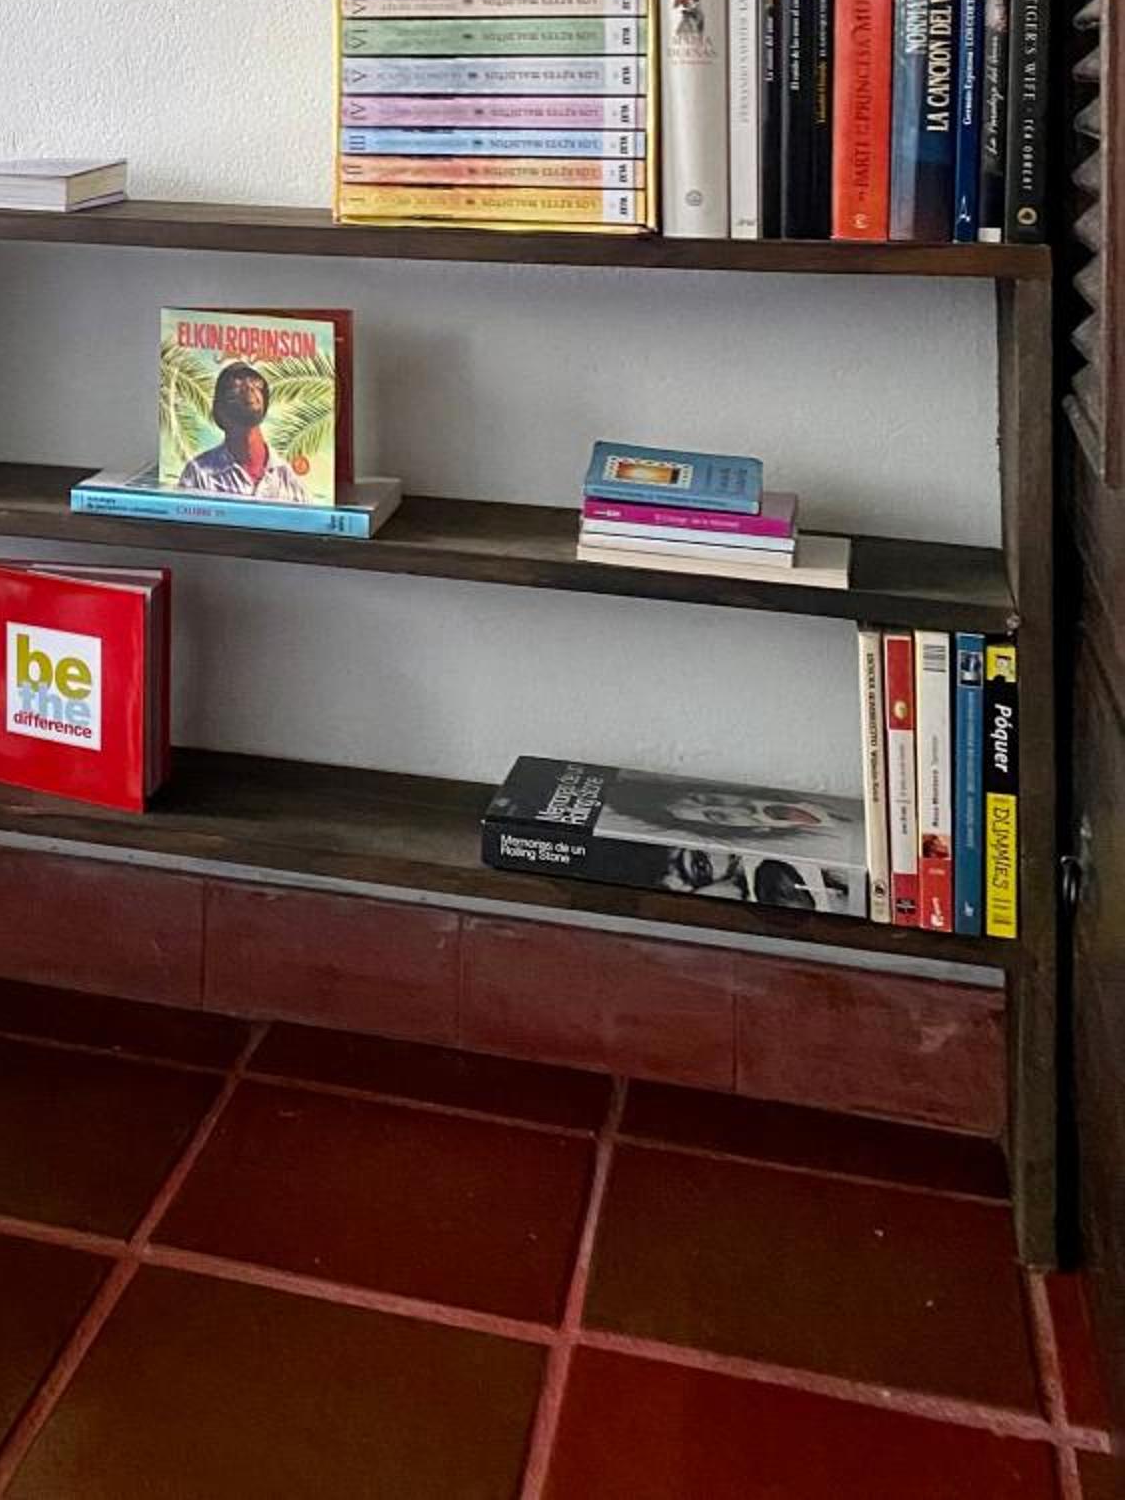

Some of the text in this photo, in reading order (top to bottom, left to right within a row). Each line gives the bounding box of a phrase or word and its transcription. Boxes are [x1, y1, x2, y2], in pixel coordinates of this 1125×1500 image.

[928, 8, 953, 36] DEL
[854, 38, 873, 121] PRINCESA
[1023, 62, 1037, 101] WIFE
[926, 111, 950, 131] LA
[177, 322, 223, 350] ELKIN
[226, 325, 316, 357] ROBINSON
[16, 633, 92, 700] be
[19, 681, 92, 726] the
[13, 710, 92, 738] difference
[992, 704, 1014, 773] Póquer
[500, 845, 571, 865] Rolling Stone
[555, 841, 570, 853] de
[571, 845, 586, 857] un
[991, 806, 1012, 890] DUMMIES
